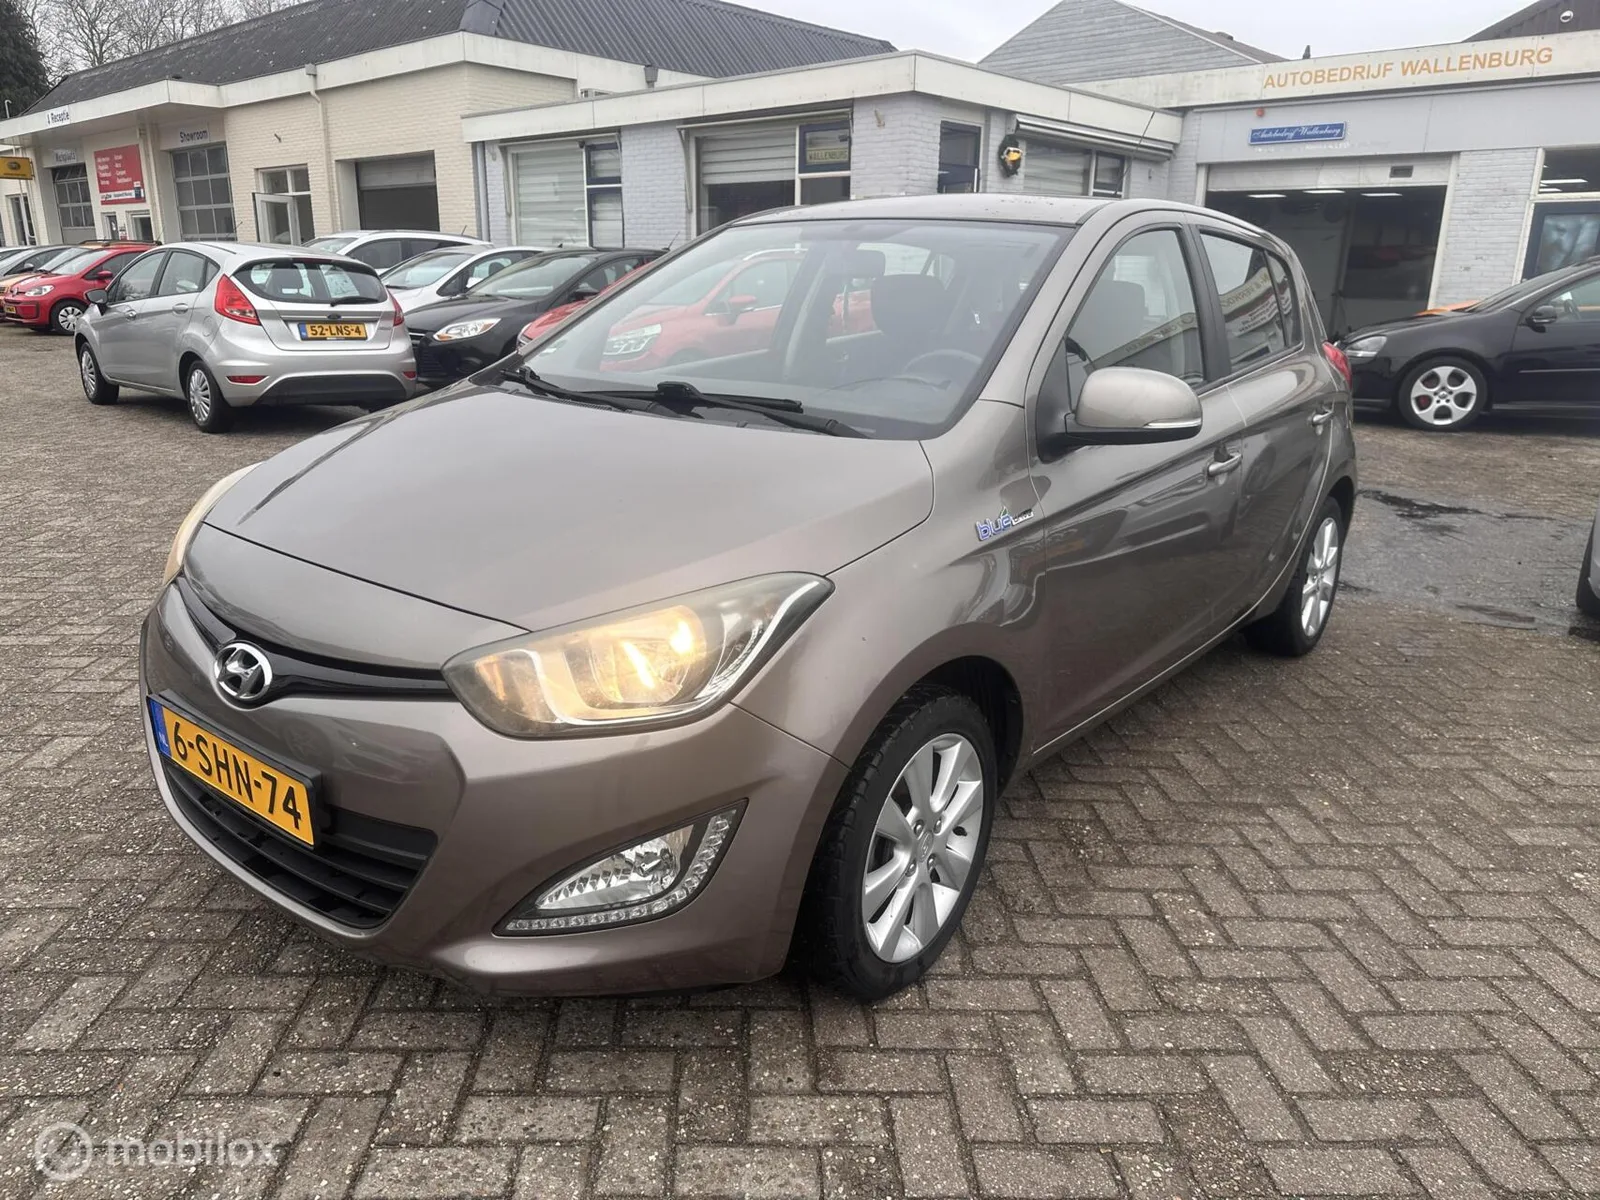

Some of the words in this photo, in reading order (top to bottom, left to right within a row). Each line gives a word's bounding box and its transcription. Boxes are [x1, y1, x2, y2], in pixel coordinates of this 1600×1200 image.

[1263, 62, 1394, 89] AUTOBEDRIJF
[1401, 47, 1553, 76] WALLENBURG
[51, 110, 70, 123] Receptie
[180, 130, 208, 143] Showroom
[1252, 128, 1298, 139] Autobedrijf
[1299, 126, 1341, 136] Wallenburg
[808, 150, 848, 161] WALLENBURG
[310, 325, 362, 336] 52-LNS-4
[975, 513, 1012, 541] blue
[173, 721, 302, 830] 6-SHN-74
